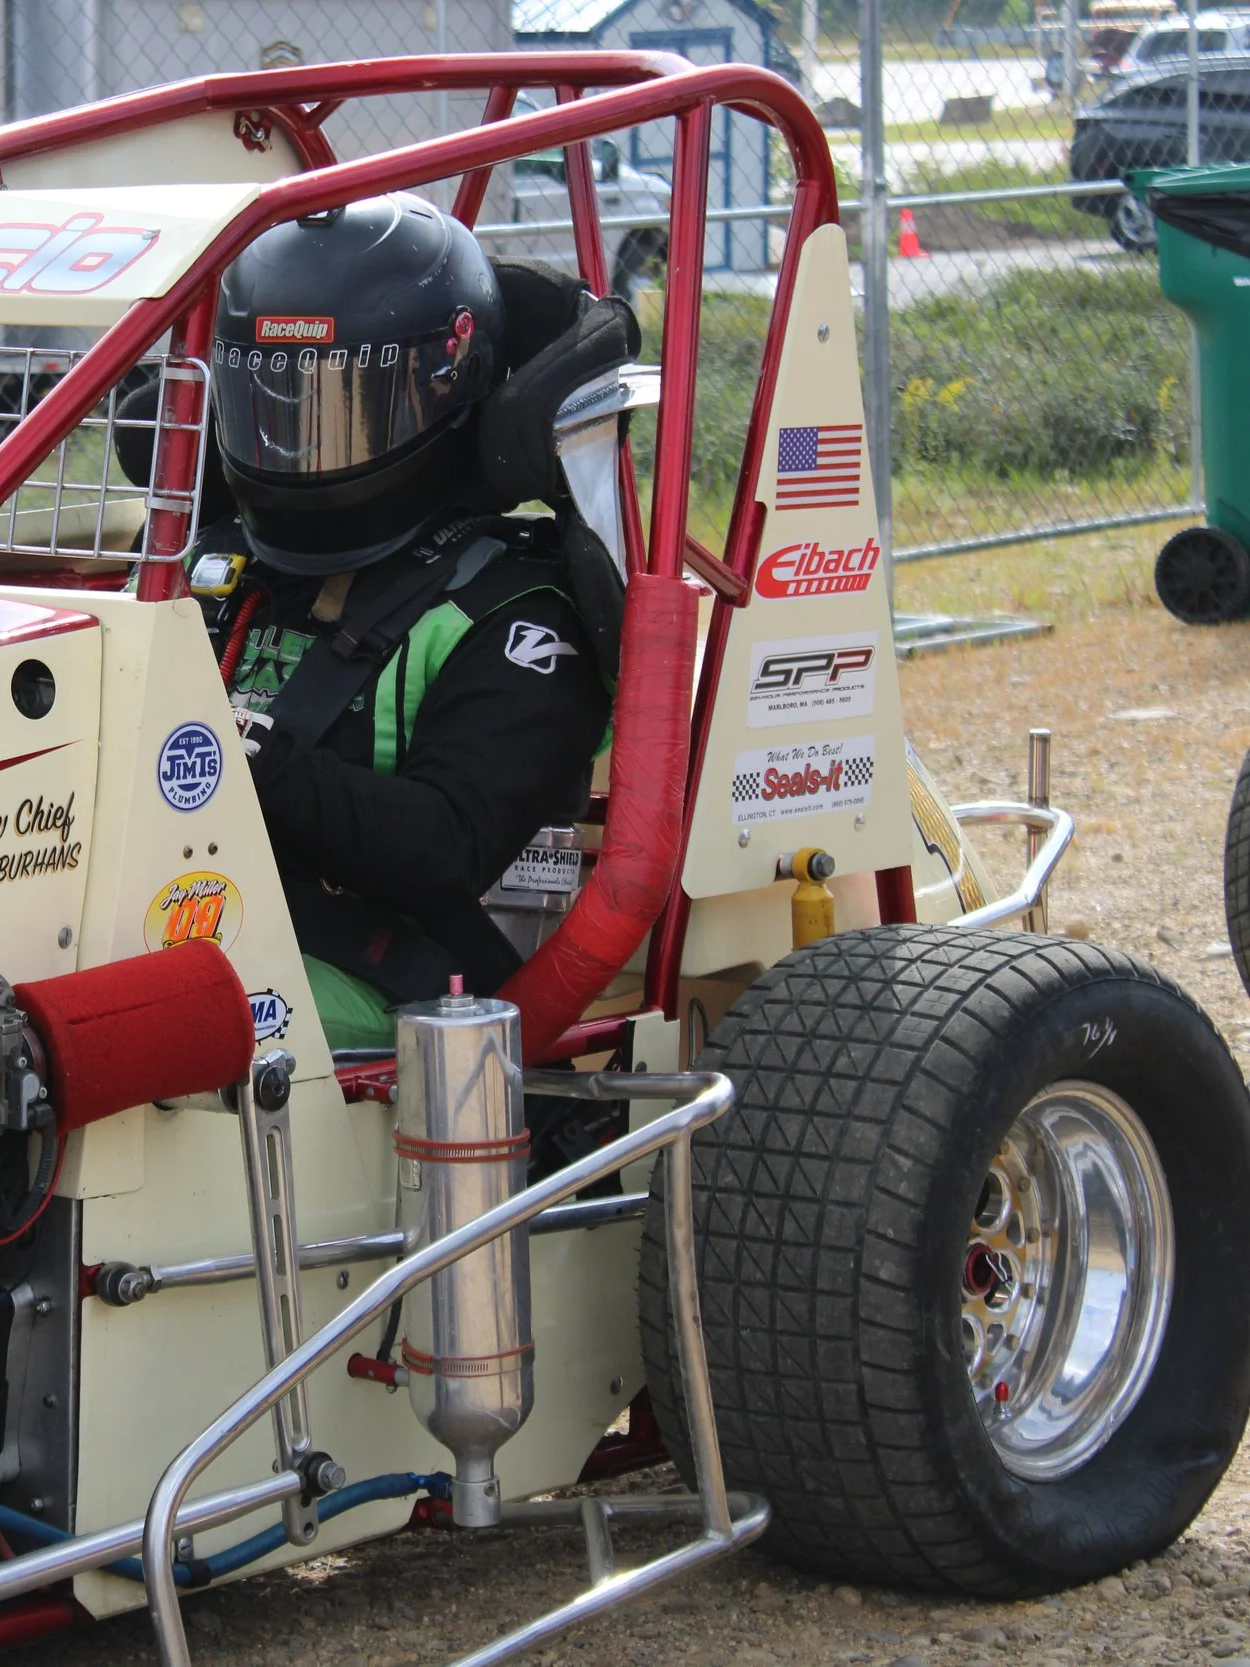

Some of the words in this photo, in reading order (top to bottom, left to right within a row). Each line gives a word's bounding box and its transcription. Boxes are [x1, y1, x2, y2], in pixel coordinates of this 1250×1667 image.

[261, 320, 329, 339] RaceQuip
[215, 340, 399, 374] RaceQuip
[755, 538, 881, 598] Eibach
[751, 646, 875, 693] SPP
[799, 700, 808, 708] MA
[179, 737, 189, 745] EST
[767, 751, 790, 763] What
[791, 748, 805, 760] We
[807, 745, 819, 758] Do
[822, 742, 845, 756] Best!
[761, 759, 844, 801] Seals-it
[168, 782, 212, 805] PLUMBING
[15, 791, 75, 842] Chief
[768, 809, 776, 817] CT
[514, 864, 536, 873] RACE
[542, 866, 575, 875] PRODUCTS
[159, 884, 188, 910] Jay
[188, 879, 227, 900] Miller
